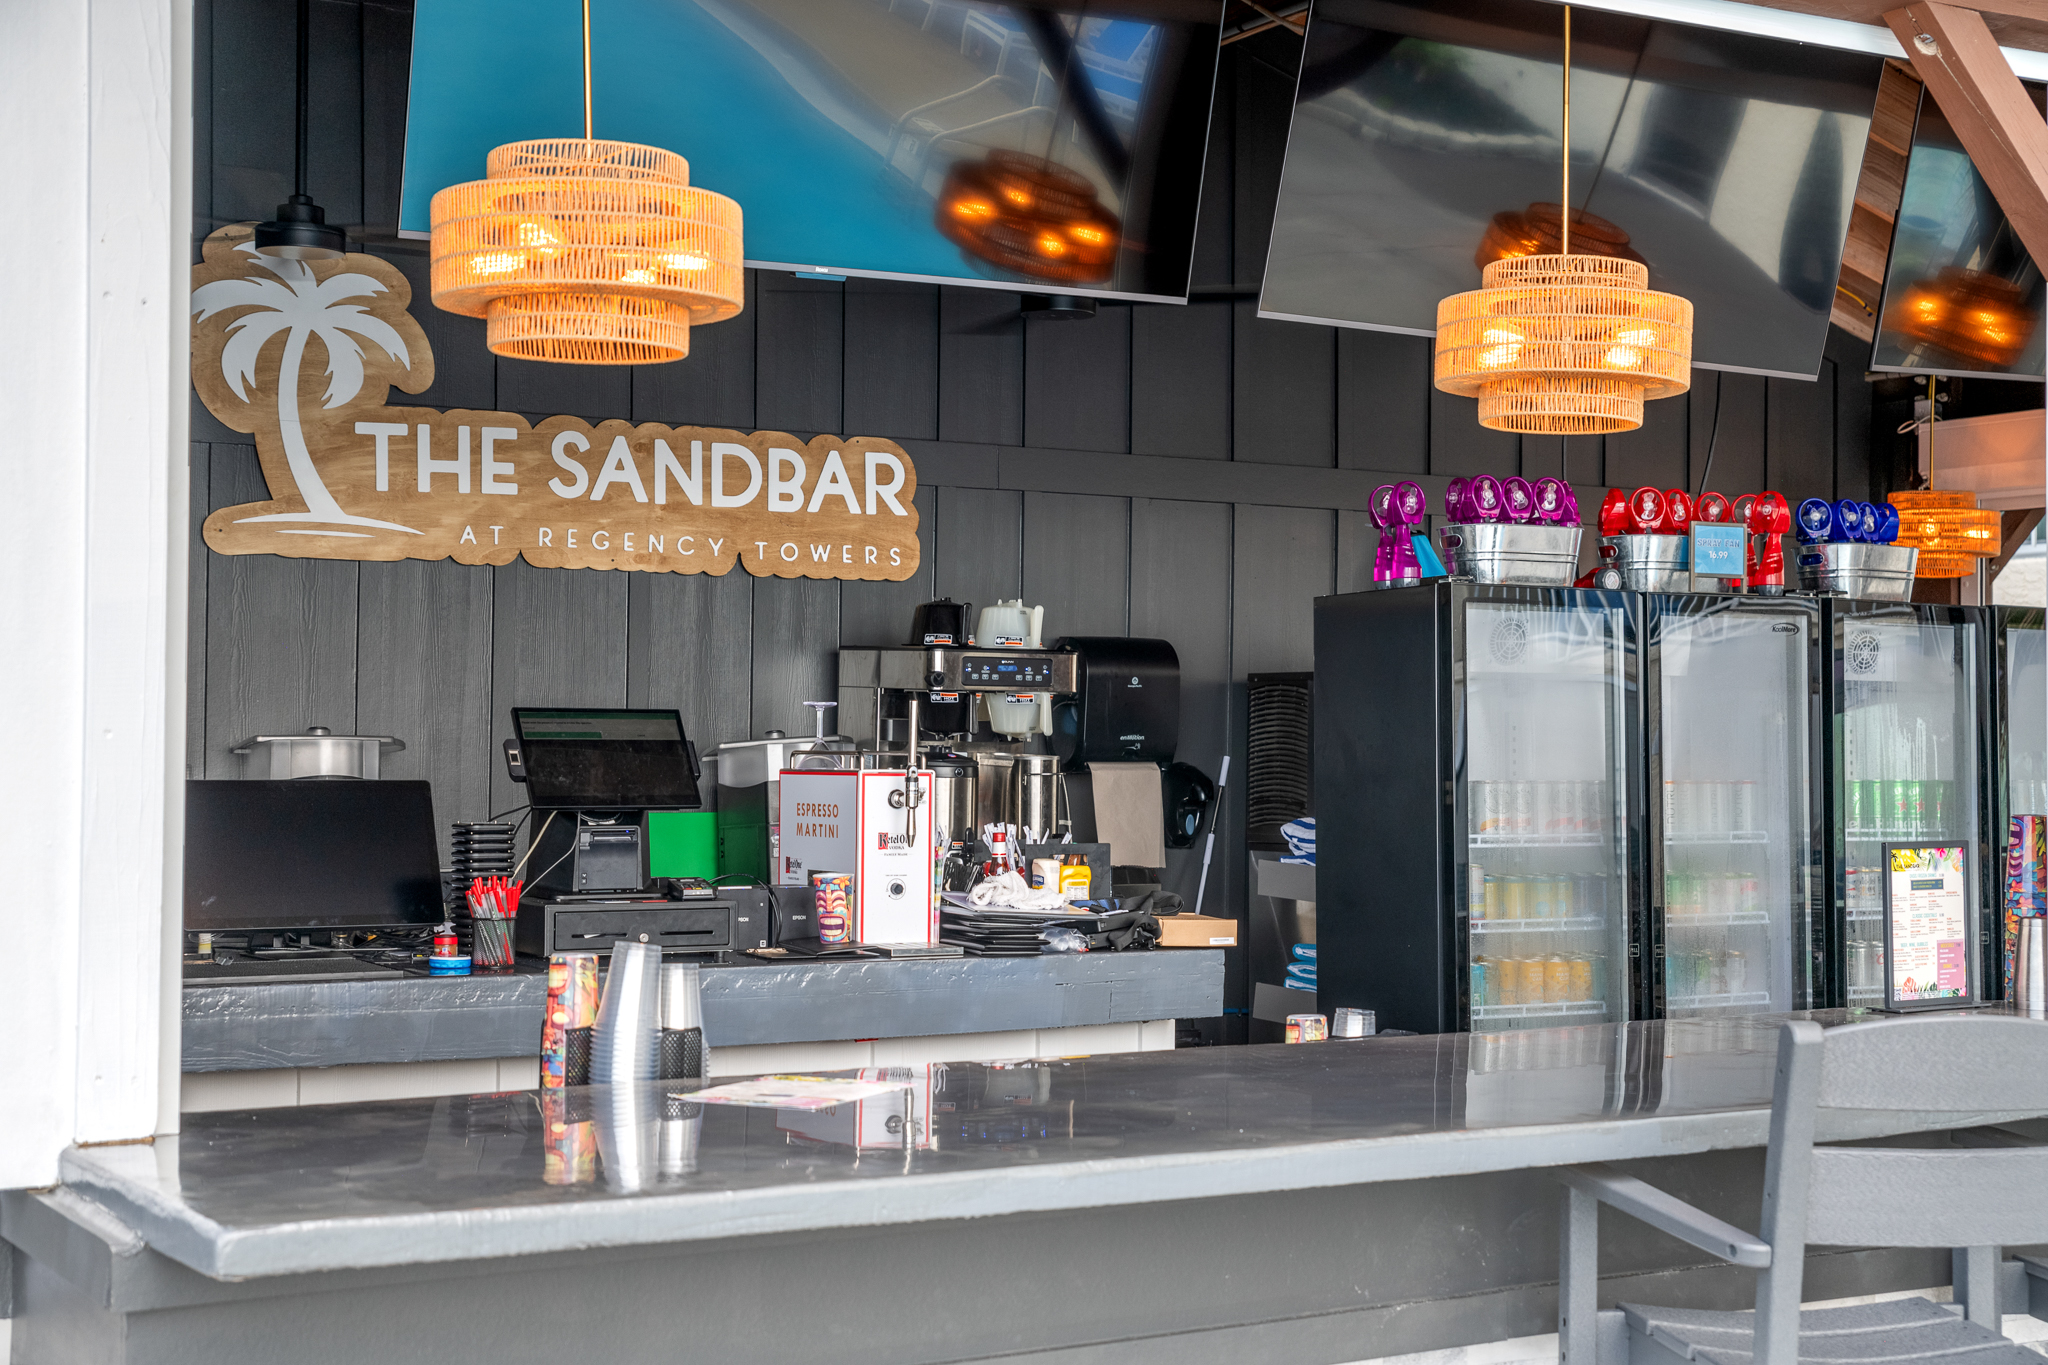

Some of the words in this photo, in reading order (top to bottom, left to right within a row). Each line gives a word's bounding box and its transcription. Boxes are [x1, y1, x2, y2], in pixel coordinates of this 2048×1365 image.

[354, 421, 519, 496] THE
[548, 430, 908, 517] SANDBAR
[459, 525, 504, 545] AT
[538, 527, 724, 557] REGENCY
[754, 541, 901, 567] TOWERS
[1697, 538, 1722, 548] SPRAY
[1724, 539, 1740, 548] FAN
[796, 802, 839, 819] ESPRESSO
[796, 822, 839, 839] MARTINI
[878, 833, 899, 849] Ketel
